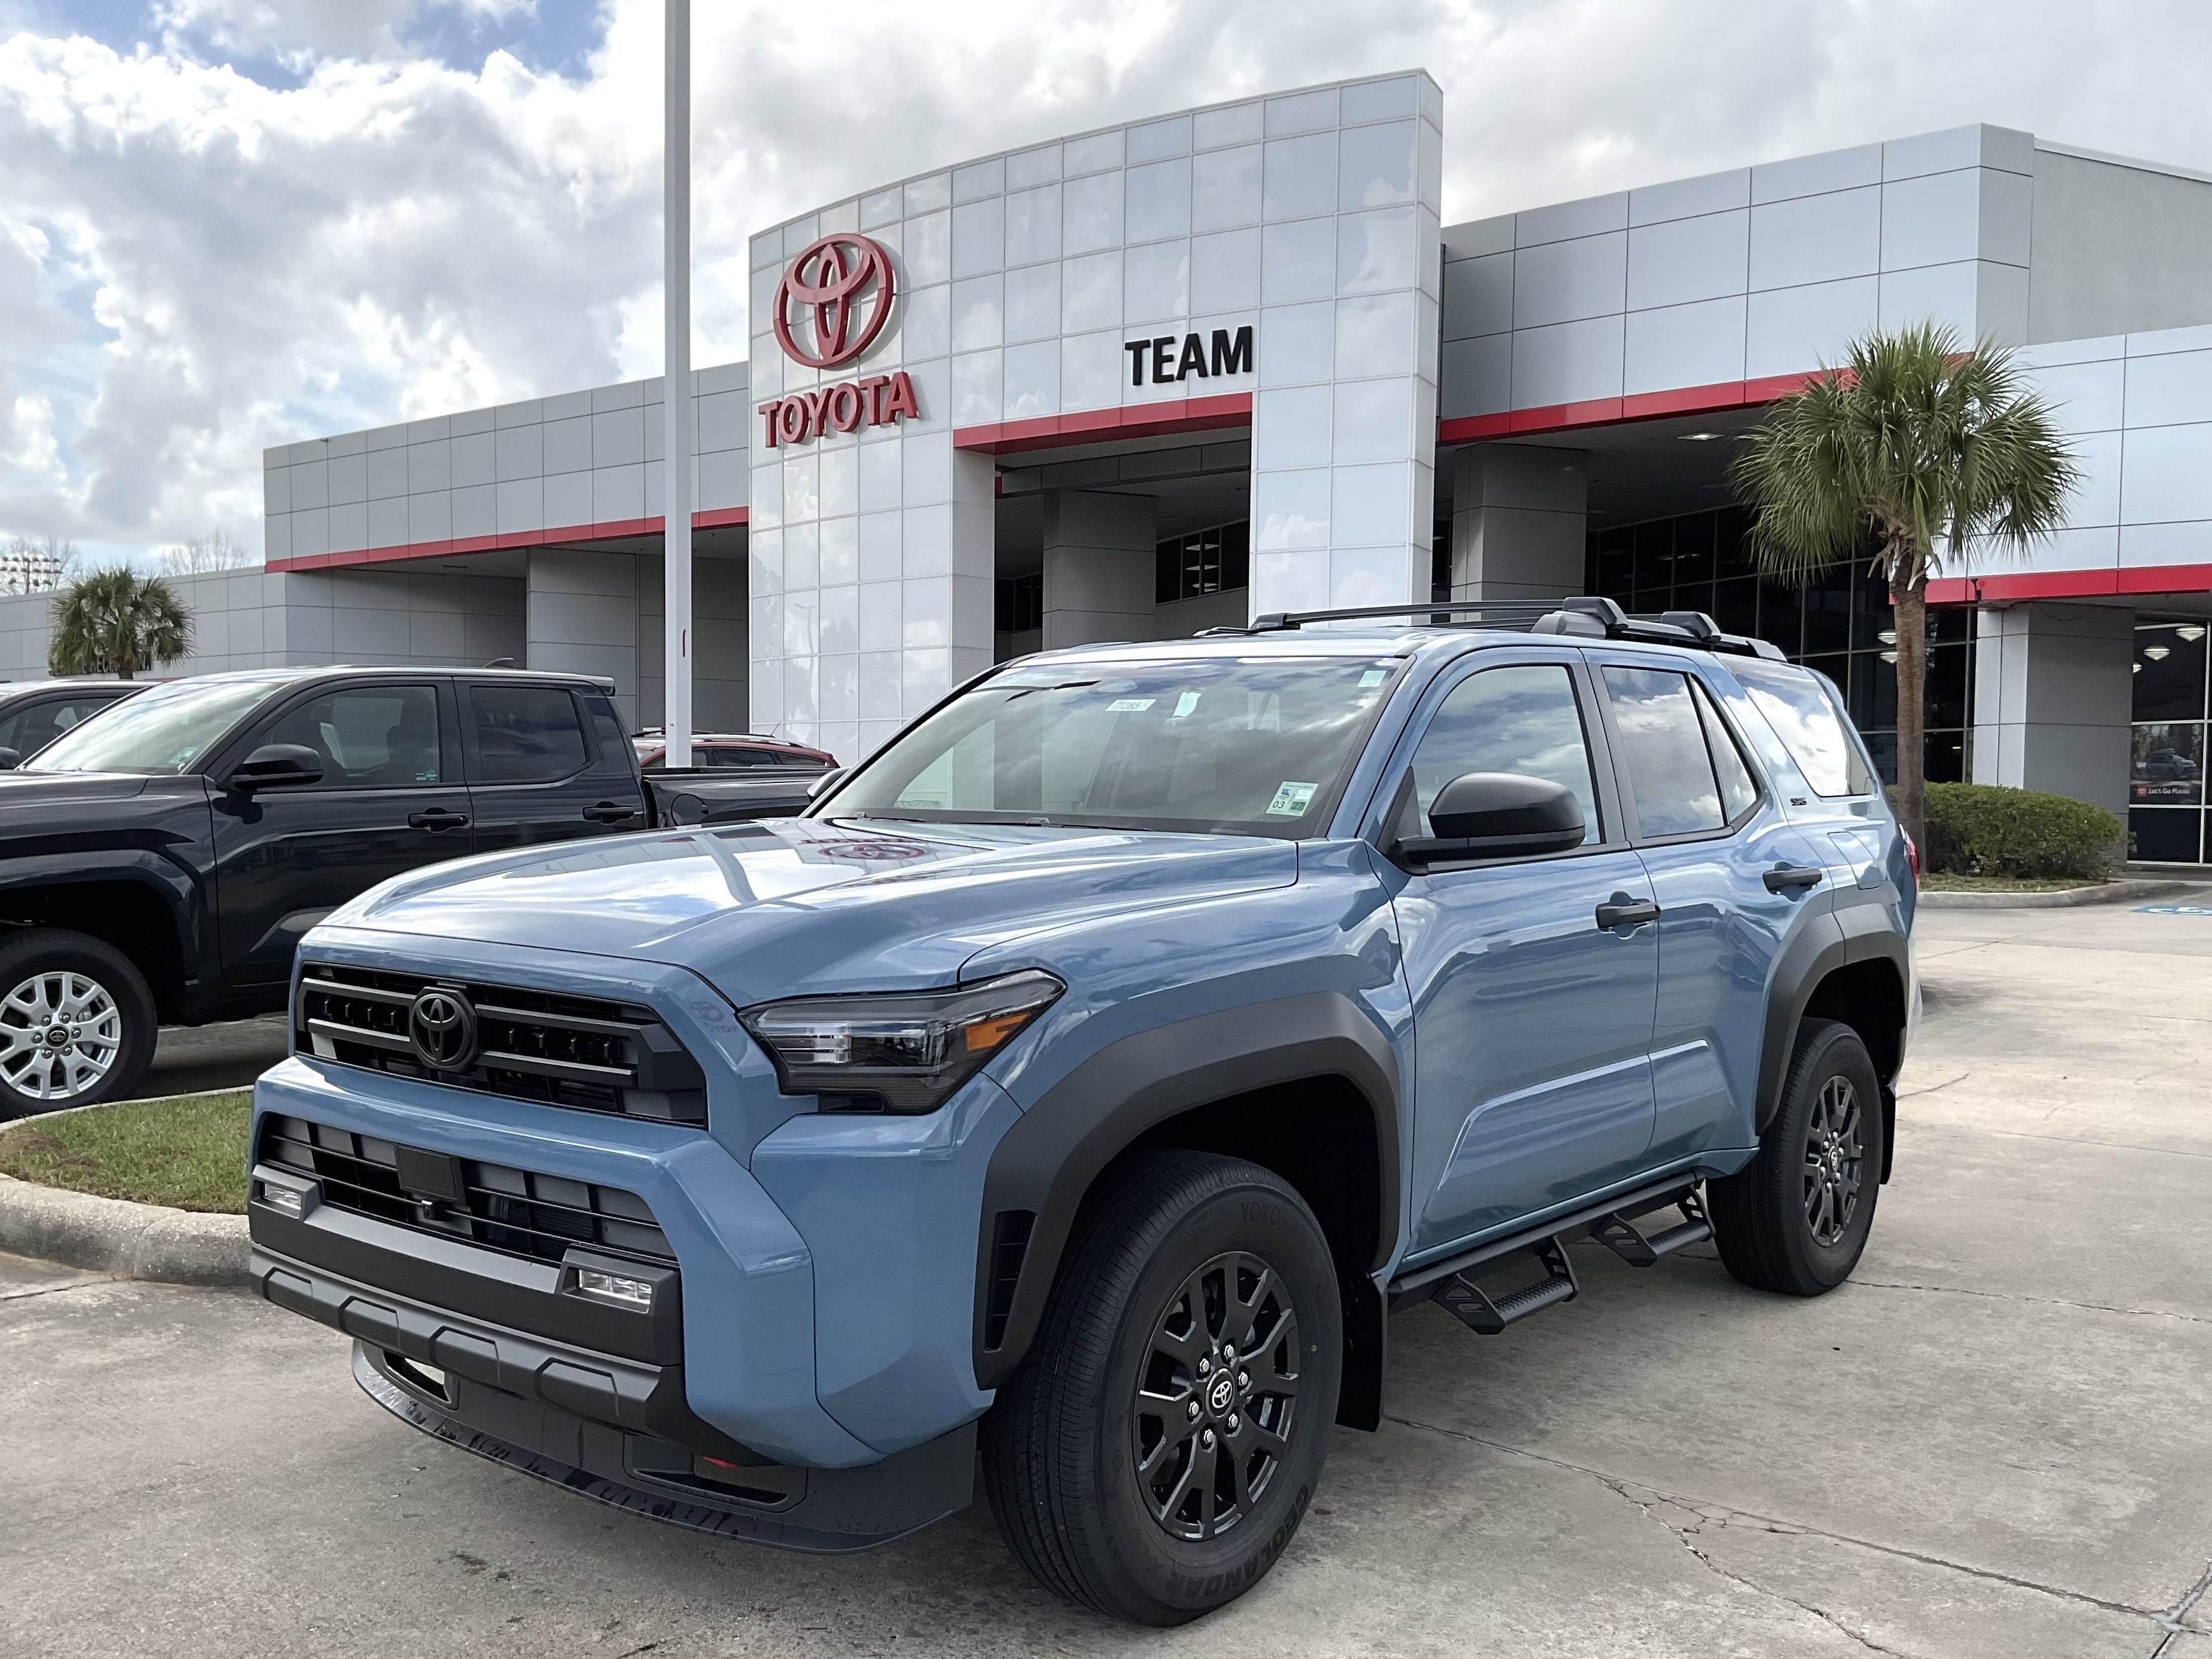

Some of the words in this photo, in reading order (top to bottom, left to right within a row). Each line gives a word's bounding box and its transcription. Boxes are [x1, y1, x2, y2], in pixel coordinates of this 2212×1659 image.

[1125, 325, 1252, 386] TEAM
[758, 371, 920, 448] TOYOTA
[1272, 800, 1285, 809] 03
[1292, 801, 1305, 810] 27
